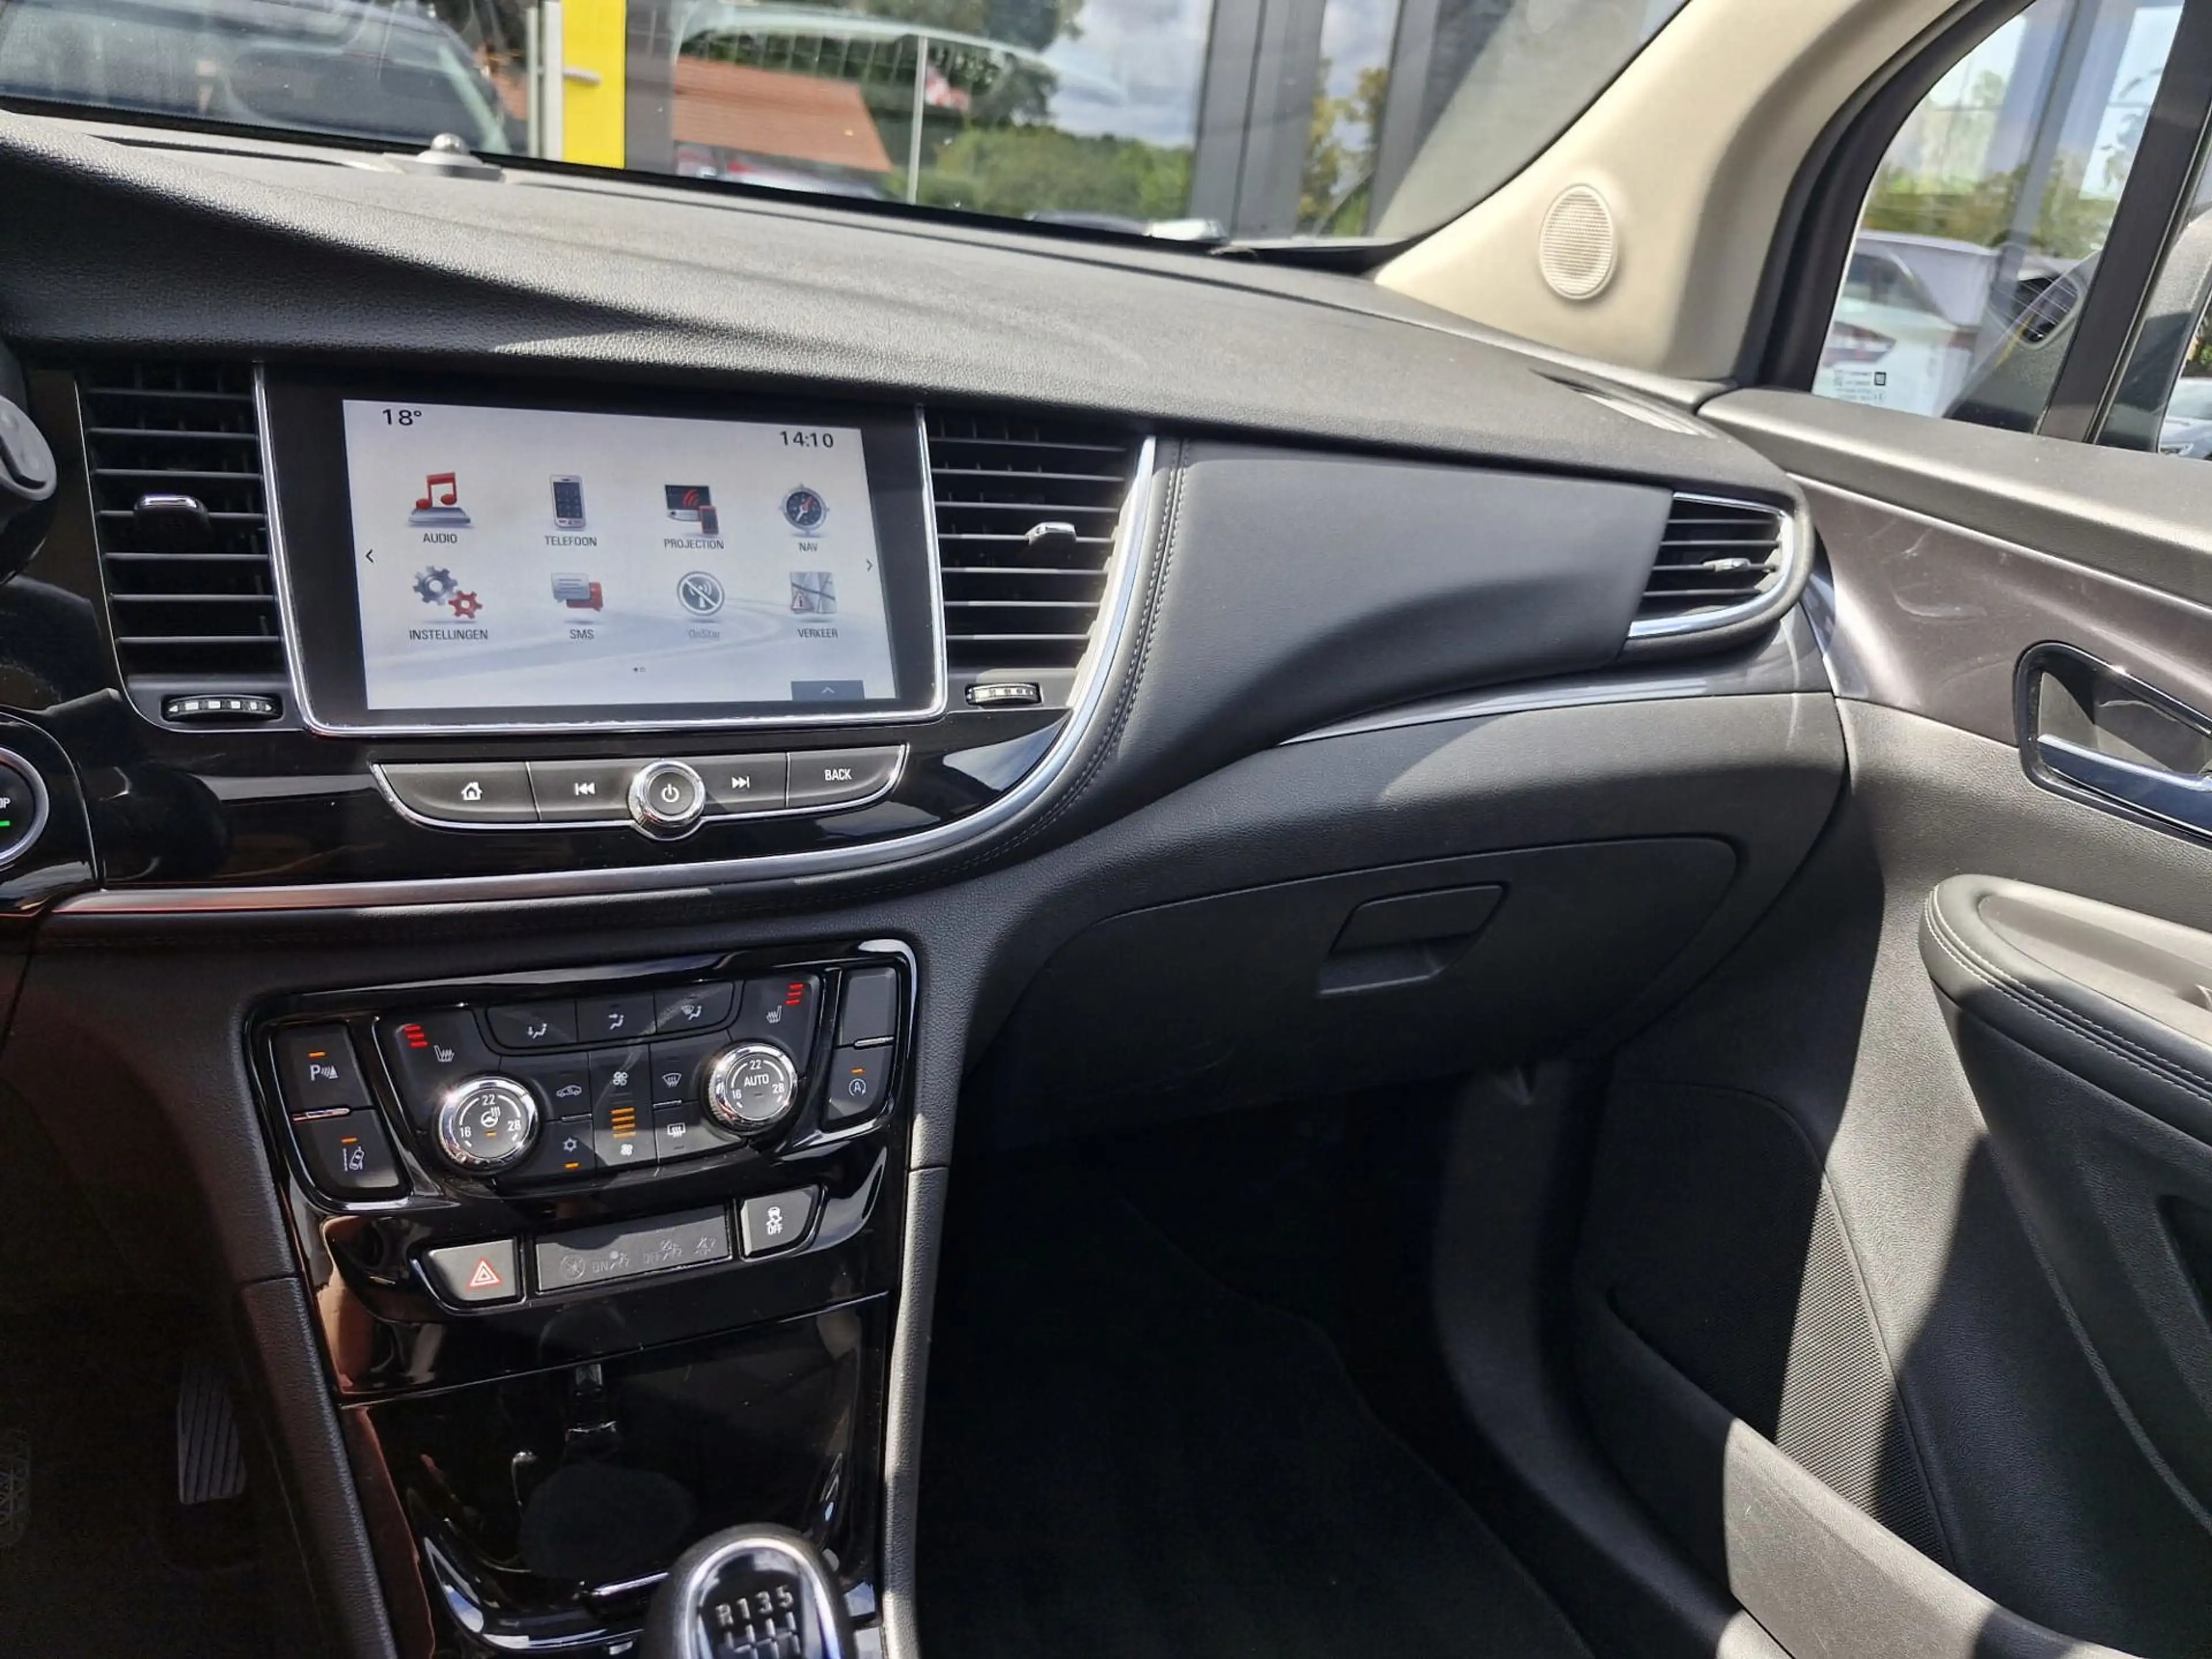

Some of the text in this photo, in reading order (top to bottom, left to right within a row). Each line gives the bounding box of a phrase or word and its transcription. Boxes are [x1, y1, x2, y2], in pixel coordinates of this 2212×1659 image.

[382, 408, 422, 426] 18°
[780, 431, 834, 448] 14:10
[423, 533, 457, 544] AUDIO
[545, 535, 597, 547] TELEFOON
[664, 538, 724, 550] PROJECTION
[798, 542, 817, 552] NAV
[409, 628, 488, 641] INSTELLINGEN
[569, 629, 594, 640] SMS
[797, 628, 838, 639] VERKEER
[824, 768, 852, 781] BACK
[750, 1059, 762, 1070] 22
[744, 1074, 769, 1087] AUTO
[772, 1082, 784, 1094] 28
[482, 1094, 495, 1106] 22
[593, 1252, 661, 1272] ON OFF
